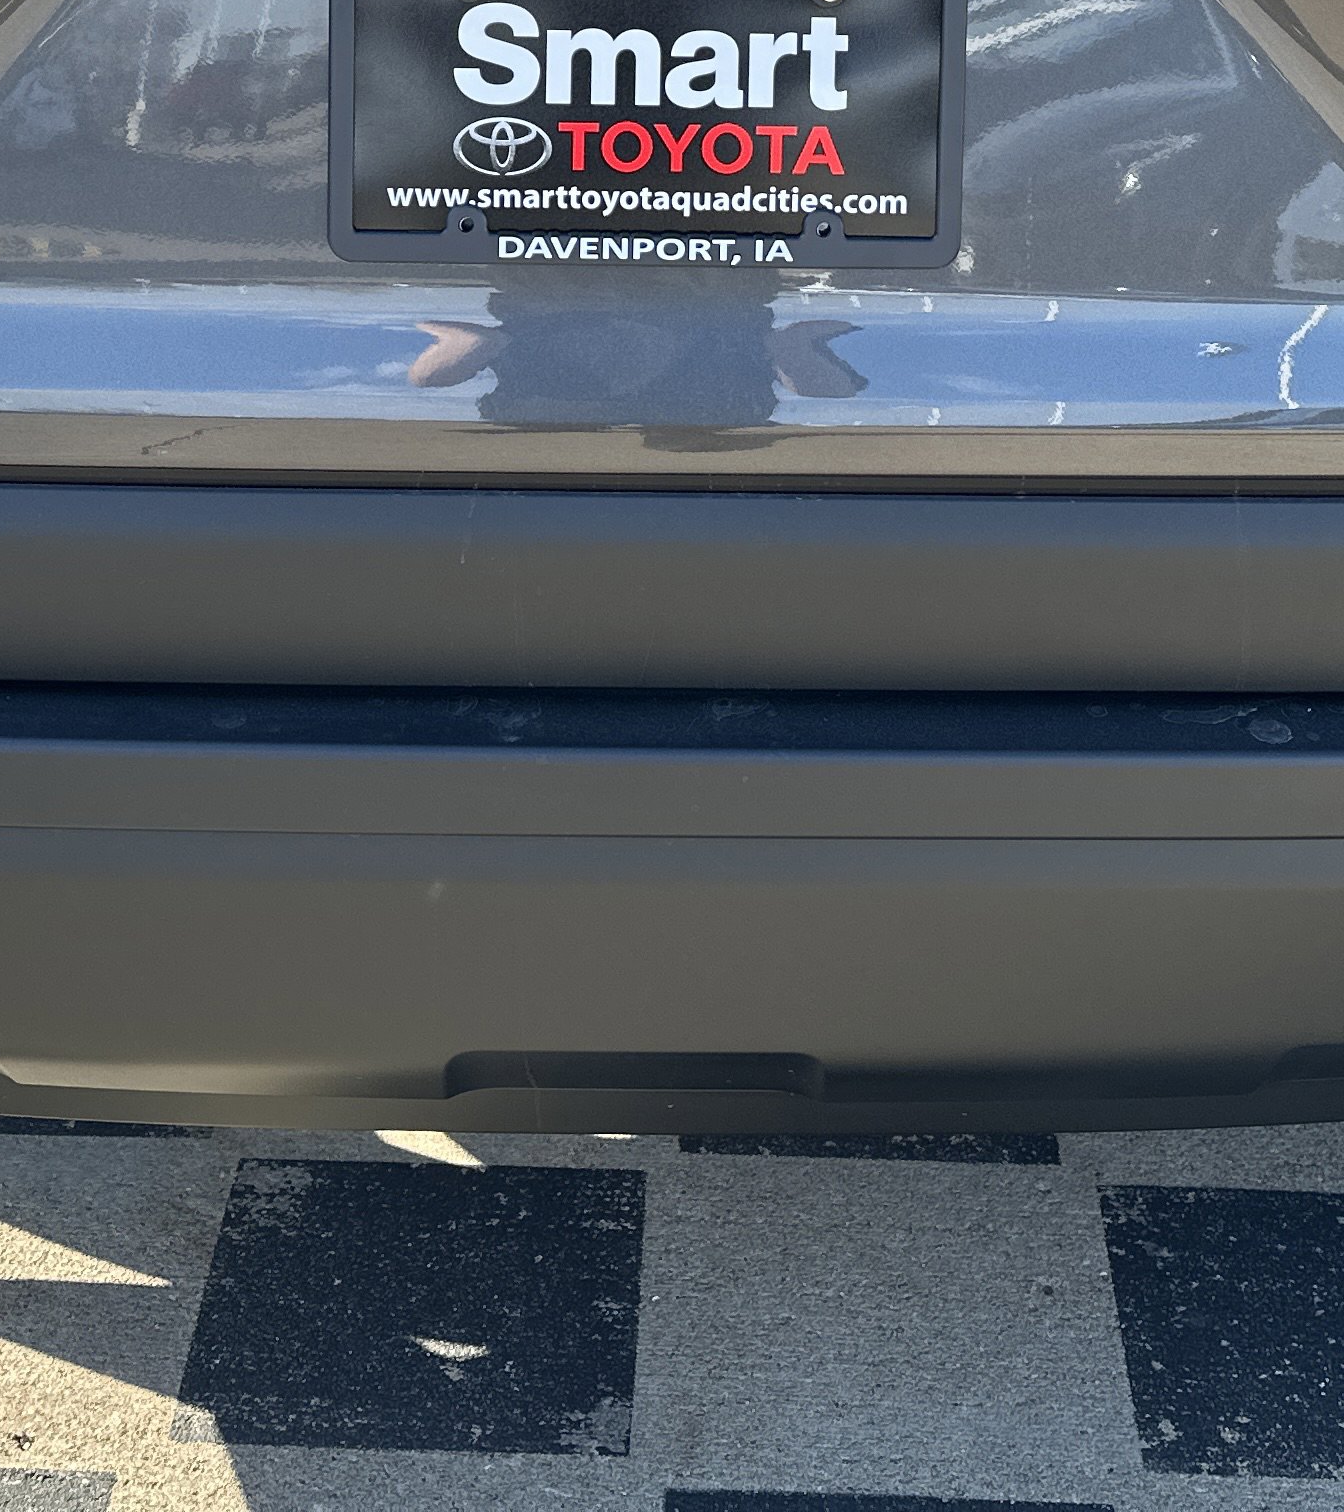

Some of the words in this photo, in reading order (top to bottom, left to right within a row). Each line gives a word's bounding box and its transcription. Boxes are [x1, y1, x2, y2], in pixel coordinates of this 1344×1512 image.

[453, 2, 849, 111] Smart
[558, 121, 846, 175] TOYOTA
[498, 236, 742, 266] DAVENPORT,
[755, 239, 794, 262] IA
